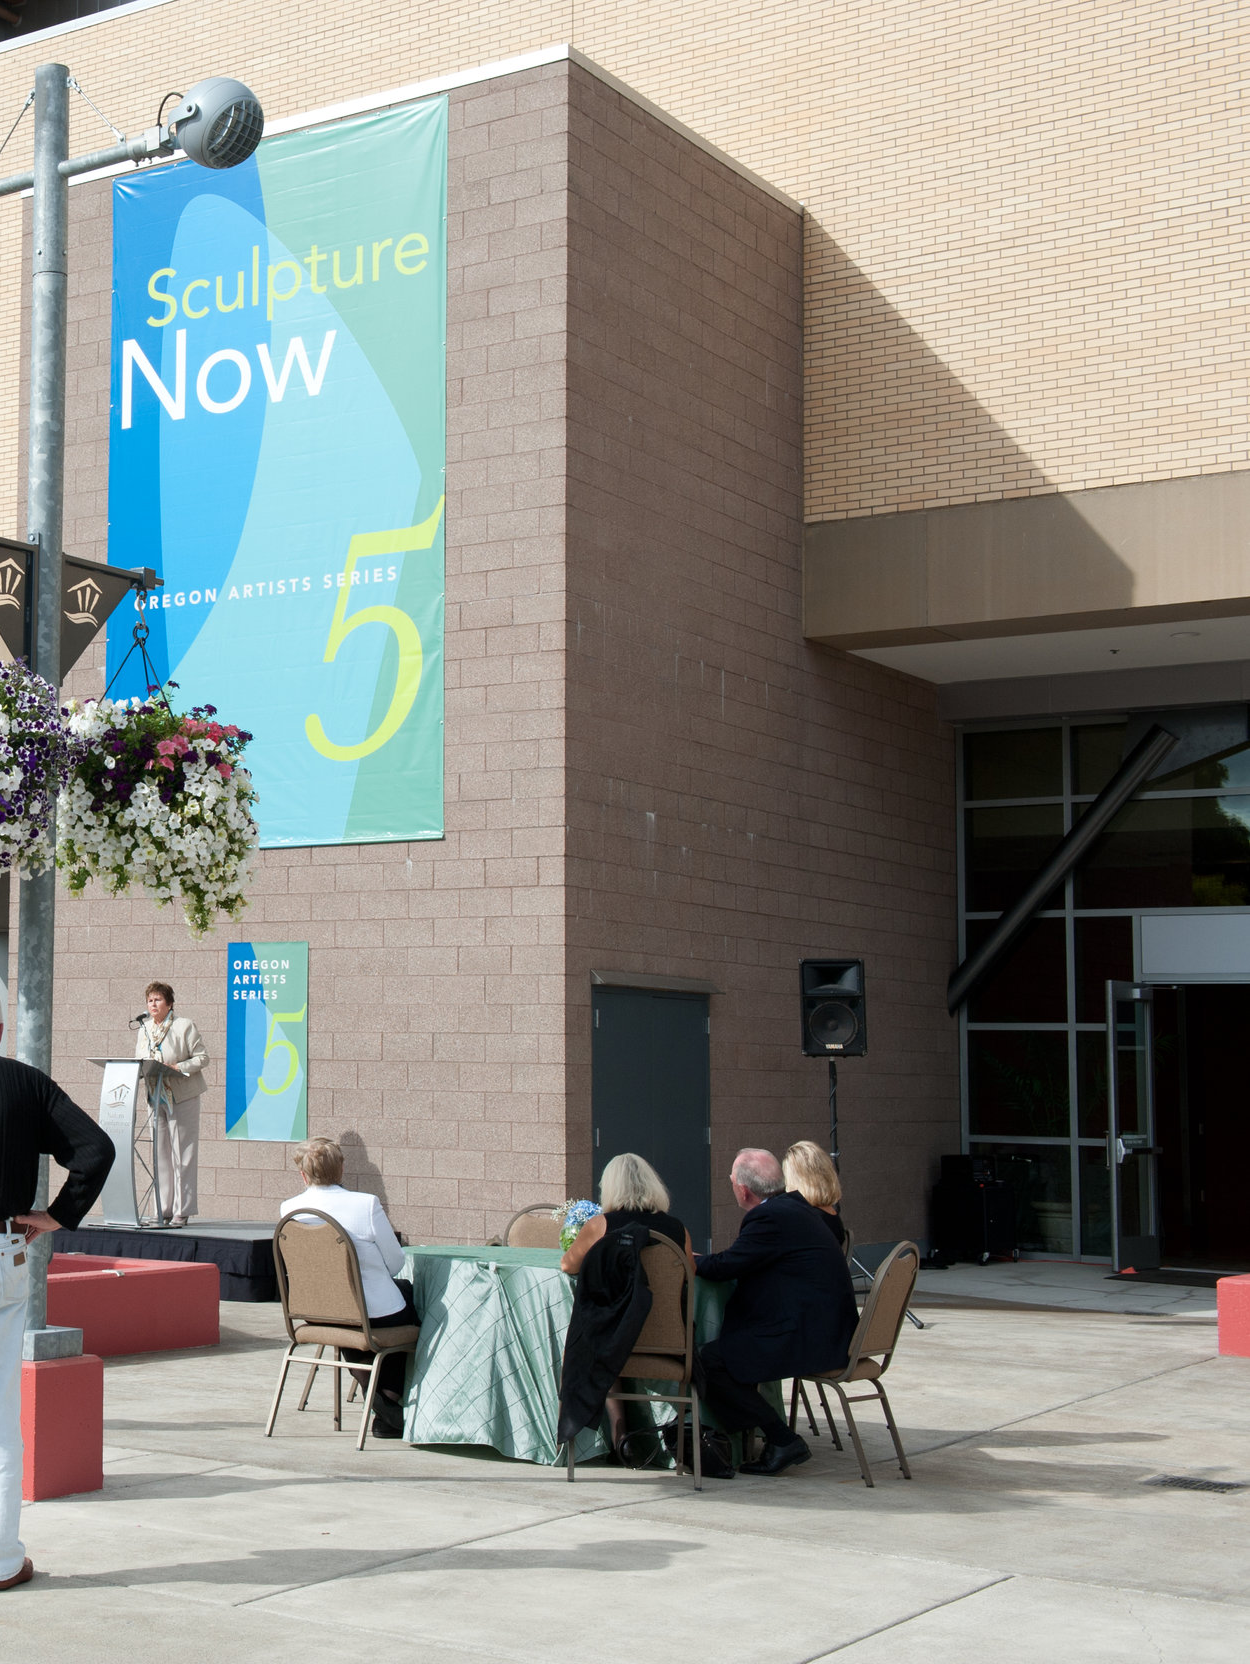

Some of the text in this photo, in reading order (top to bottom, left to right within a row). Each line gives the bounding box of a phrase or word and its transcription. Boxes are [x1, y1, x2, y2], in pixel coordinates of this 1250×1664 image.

[146, 232, 430, 328] Sculpture
[120, 328, 338, 430] Now
[133, 566, 398, 612] OREGON ARTISTS SERIES
[304, 494, 446, 762] 5
[233, 959, 290, 970] OREGON
[233, 974, 287, 985] ARTISTS
[233, 989, 278, 1000] SERIES
[257, 1002, 307, 1096] 5
